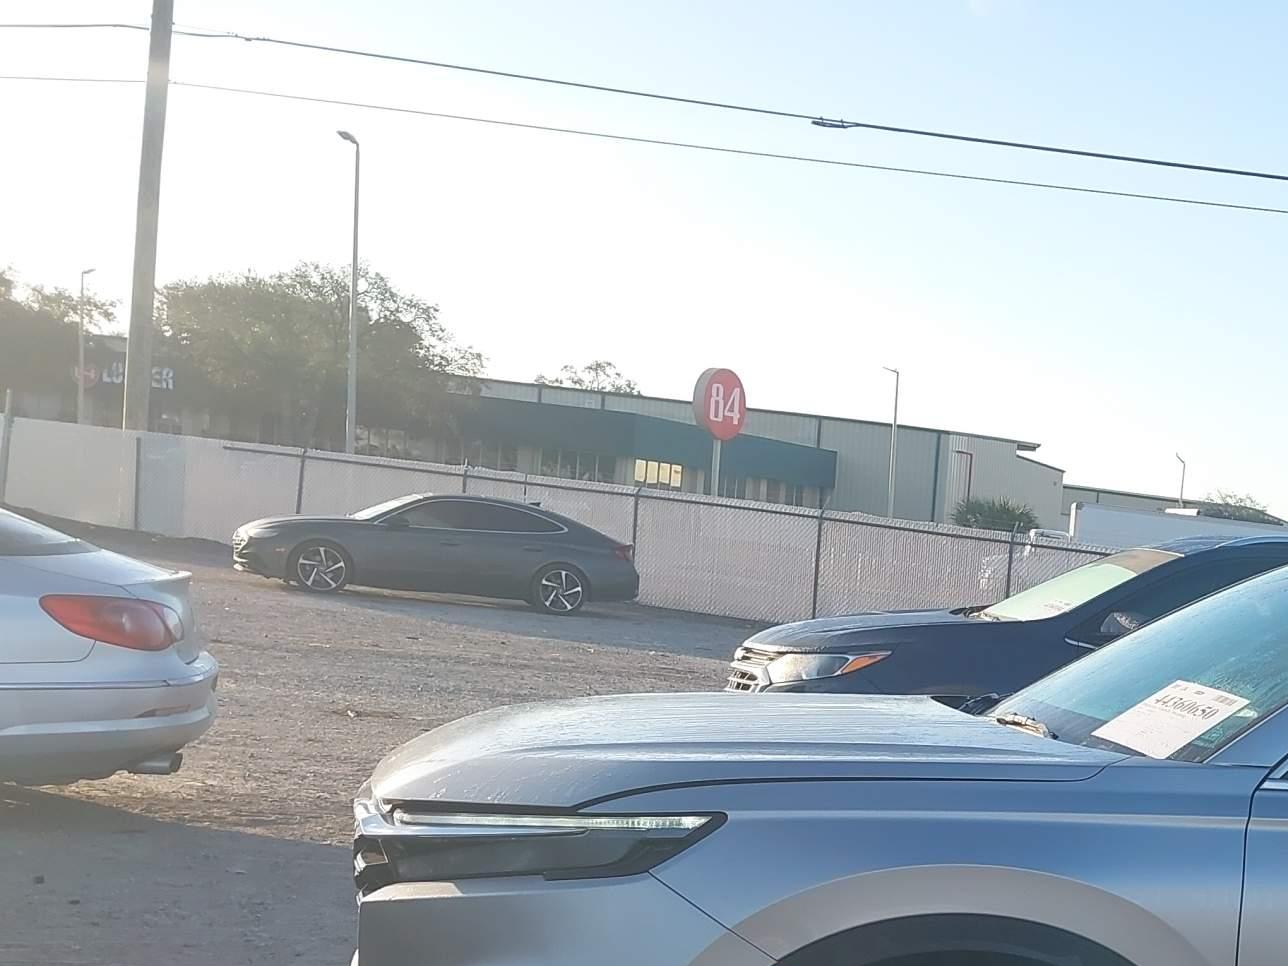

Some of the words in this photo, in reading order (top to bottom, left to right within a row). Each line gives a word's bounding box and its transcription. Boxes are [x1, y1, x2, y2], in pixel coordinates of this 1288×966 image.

[102, 361, 174, 390] LUER
[709, 383, 741, 425] 84
[1154, 694, 1220, 721] 44360650
